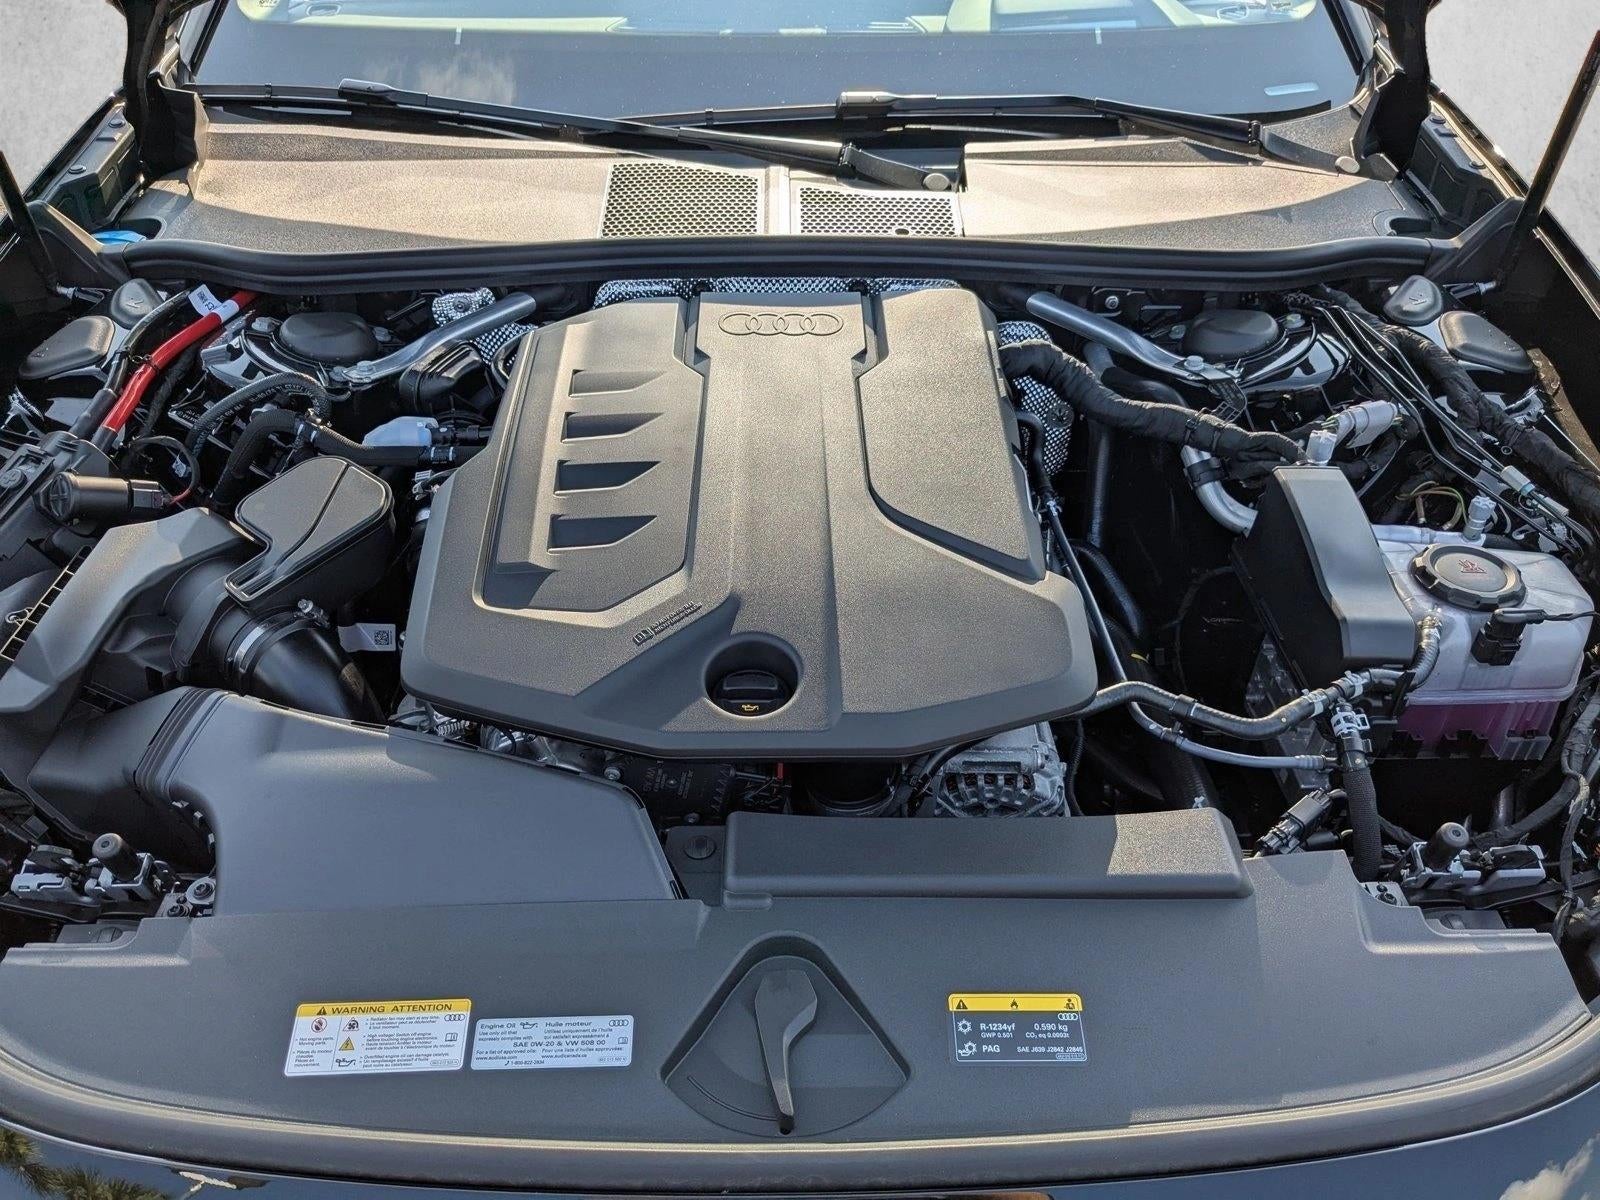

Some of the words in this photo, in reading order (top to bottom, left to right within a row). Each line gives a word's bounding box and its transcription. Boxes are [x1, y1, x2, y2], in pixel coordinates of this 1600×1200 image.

[331, 1006, 385, 1014] WARNING
[391, 1004, 452, 1012] ATTENTION
[980, 1023, 1016, 1032] R-1234yf
[1058, 1023, 1068, 1032] kg
